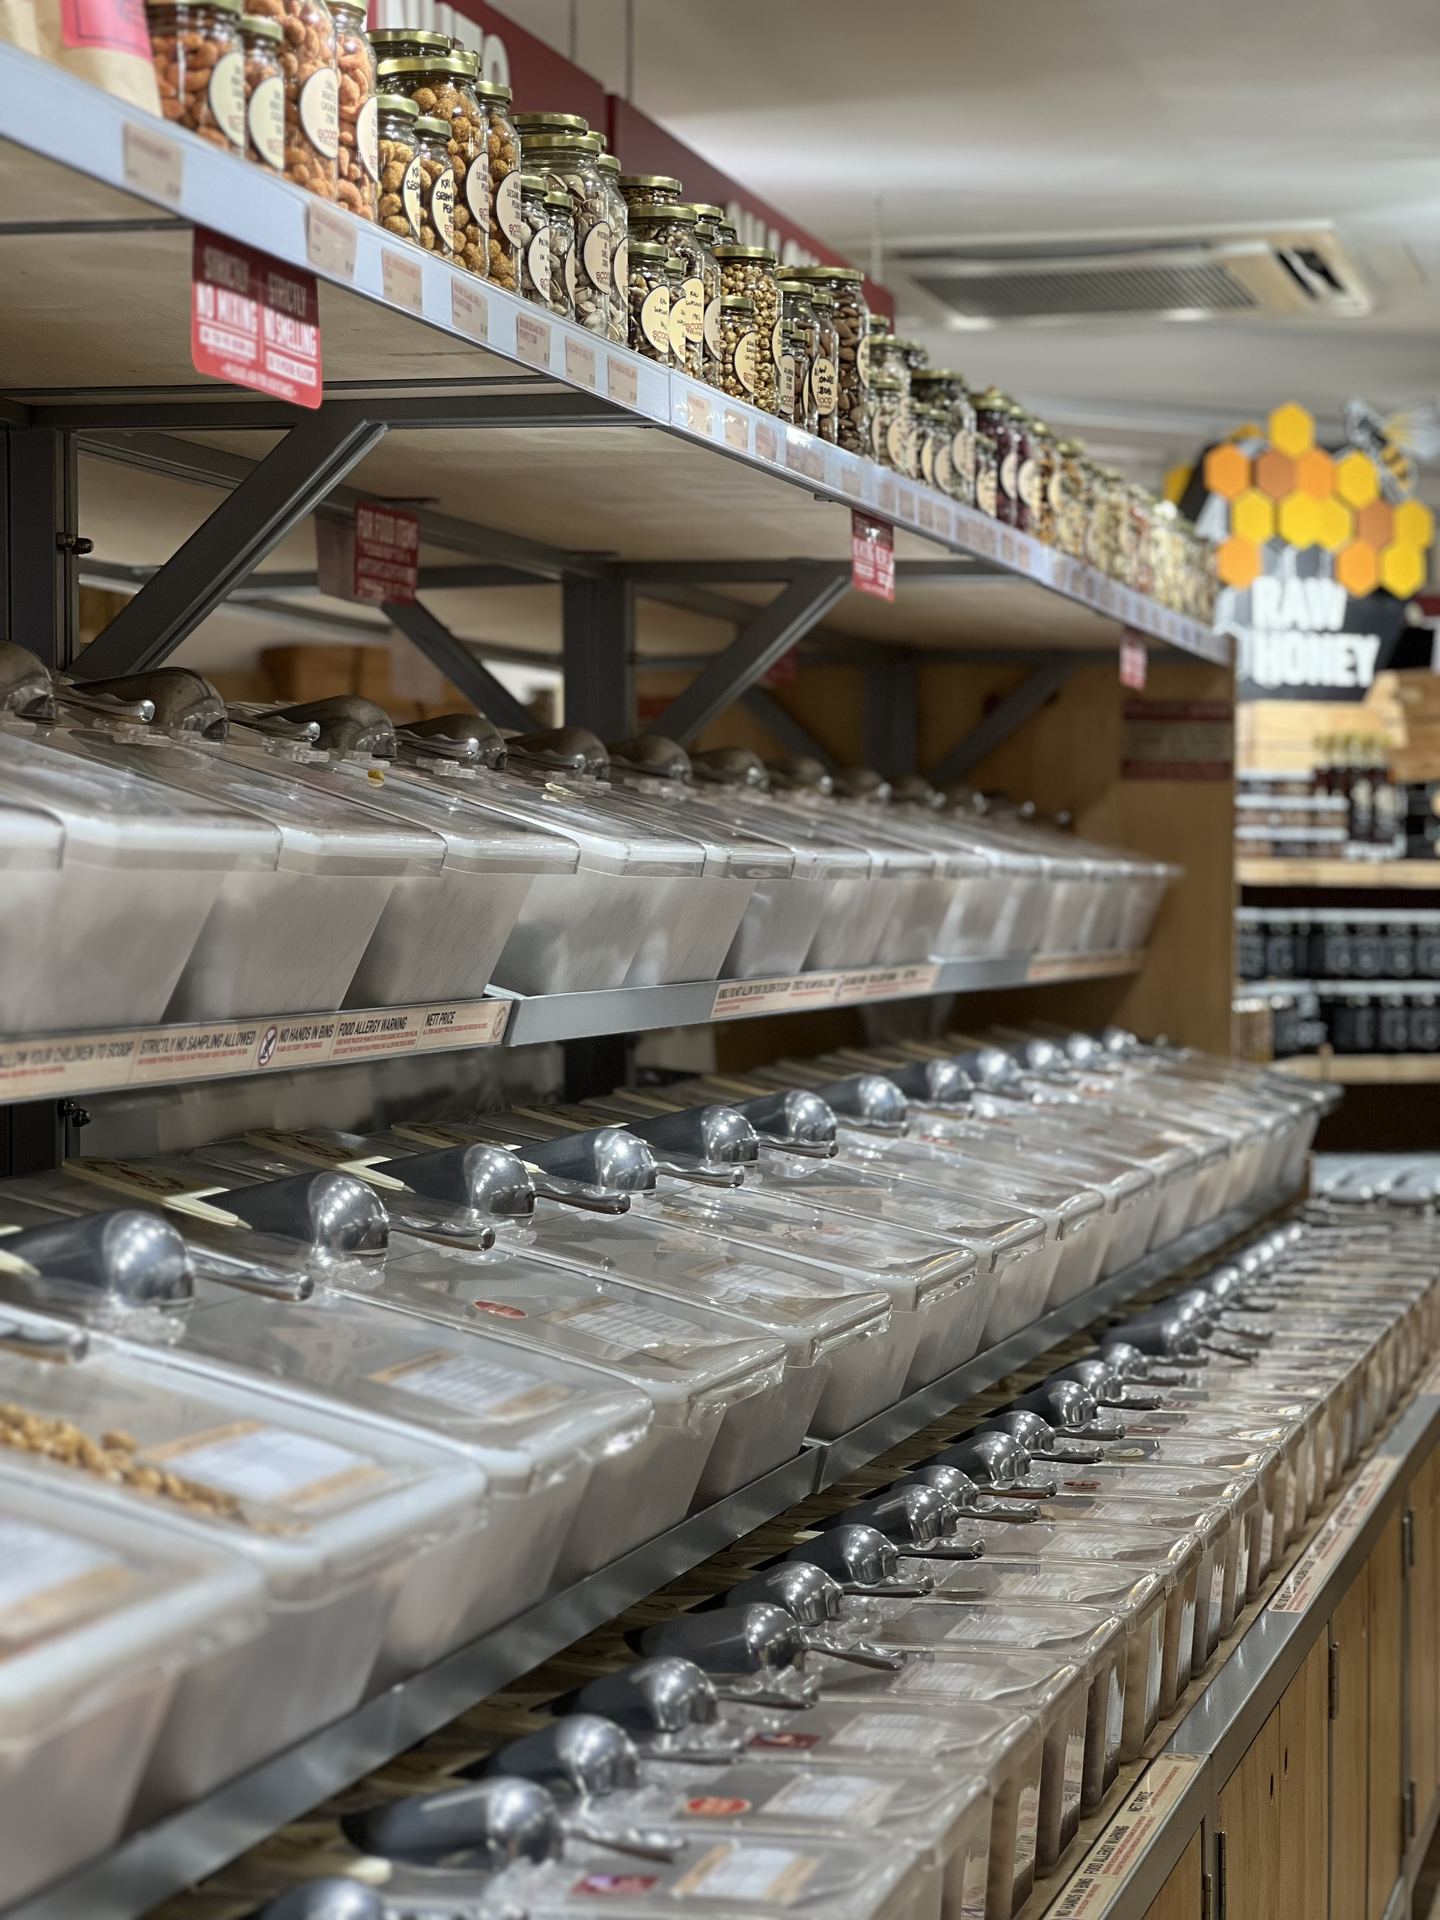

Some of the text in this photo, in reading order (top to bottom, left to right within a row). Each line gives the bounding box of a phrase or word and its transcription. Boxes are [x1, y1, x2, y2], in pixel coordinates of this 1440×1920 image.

[1251, 576, 1348, 632] RAW
[1251, 631, 1381, 689] HONEY
[337, 1021, 354, 1037] FOOD
[354, 1019, 382, 1036] ALLERGY
[380, 1016, 408, 1033] WARNING
[424, 1011, 456, 1027] NETT PRICE
[139, 1036, 176, 1055] STRICTLY
[174, 1037, 188, 1052] NO
[186, 1033, 225, 1051] SAMPLING
[222, 1030, 257, 1049] ALLOWED
[279, 1024, 335, 1043] NO HANDS IN BINS
[107, 1040, 135, 1058] SCOOP
[1106, 1825, 1130, 1846] WARNING
[1092, 1841, 1116, 1866] ALLERGY
[1083, 1859, 1102, 1875] FOOD
[1073, 1885, 1086, 1896] IN
[1078, 1876, 1094, 1890] BINS
[1055, 1905, 1069, 1918] NO
[1063, 1891, 1081, 1913] HANDS
